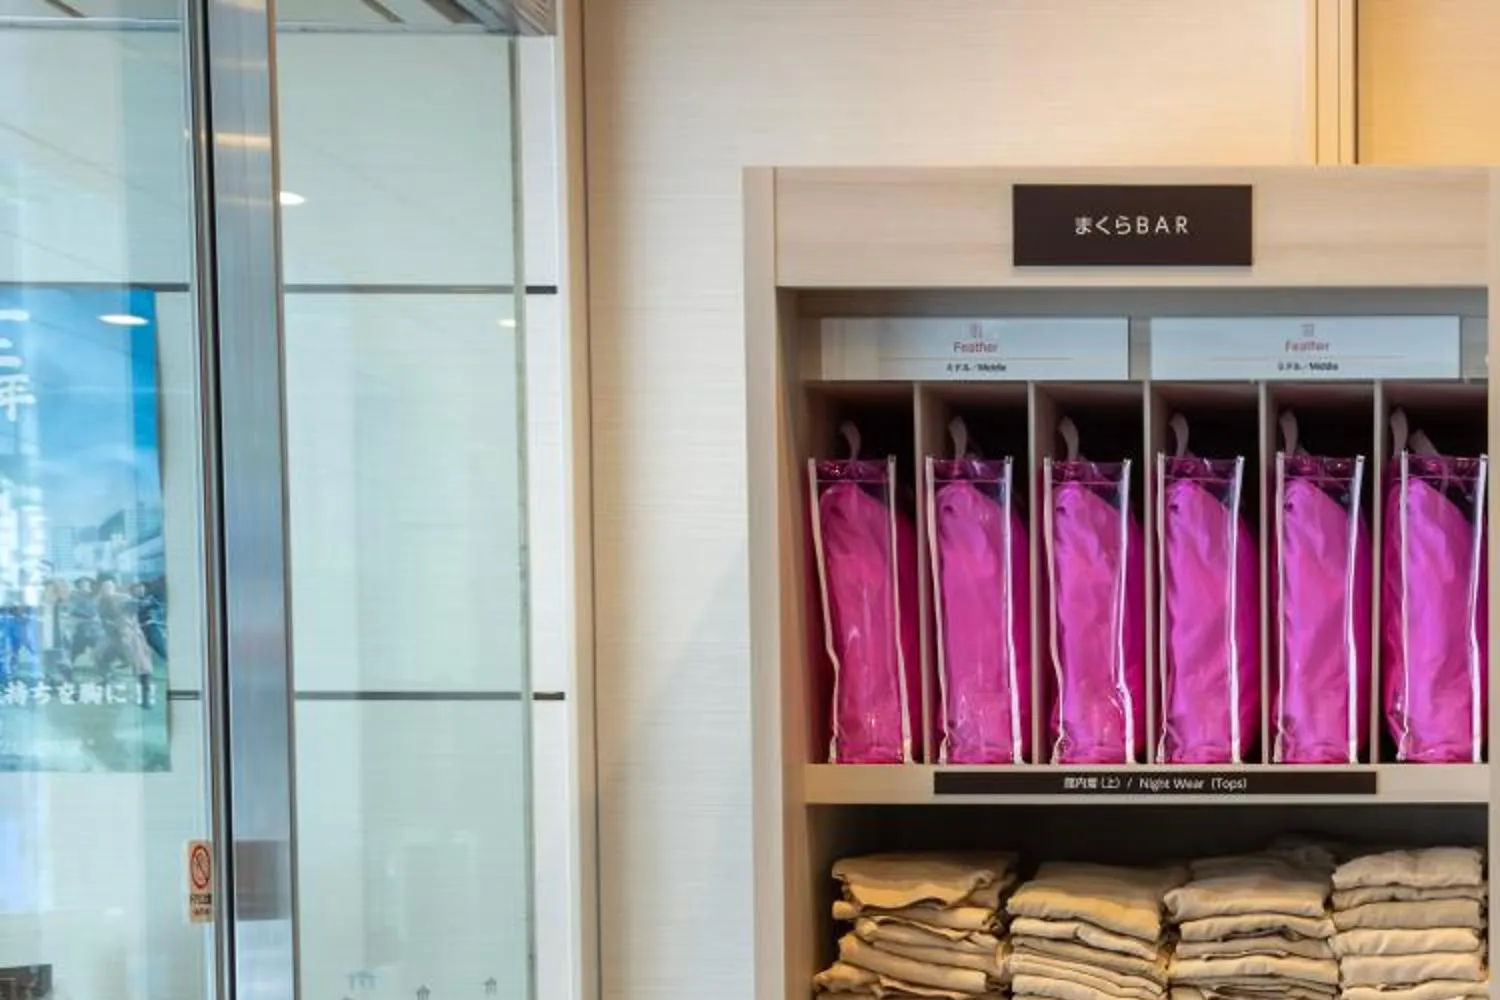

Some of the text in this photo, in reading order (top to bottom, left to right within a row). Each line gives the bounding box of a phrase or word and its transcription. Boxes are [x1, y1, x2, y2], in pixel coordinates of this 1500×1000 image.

[1075, 215, 1190, 235] まくらBAR
[1140, 777, 1169, 792] Night
[1173, 777, 1204, 789] Wear
